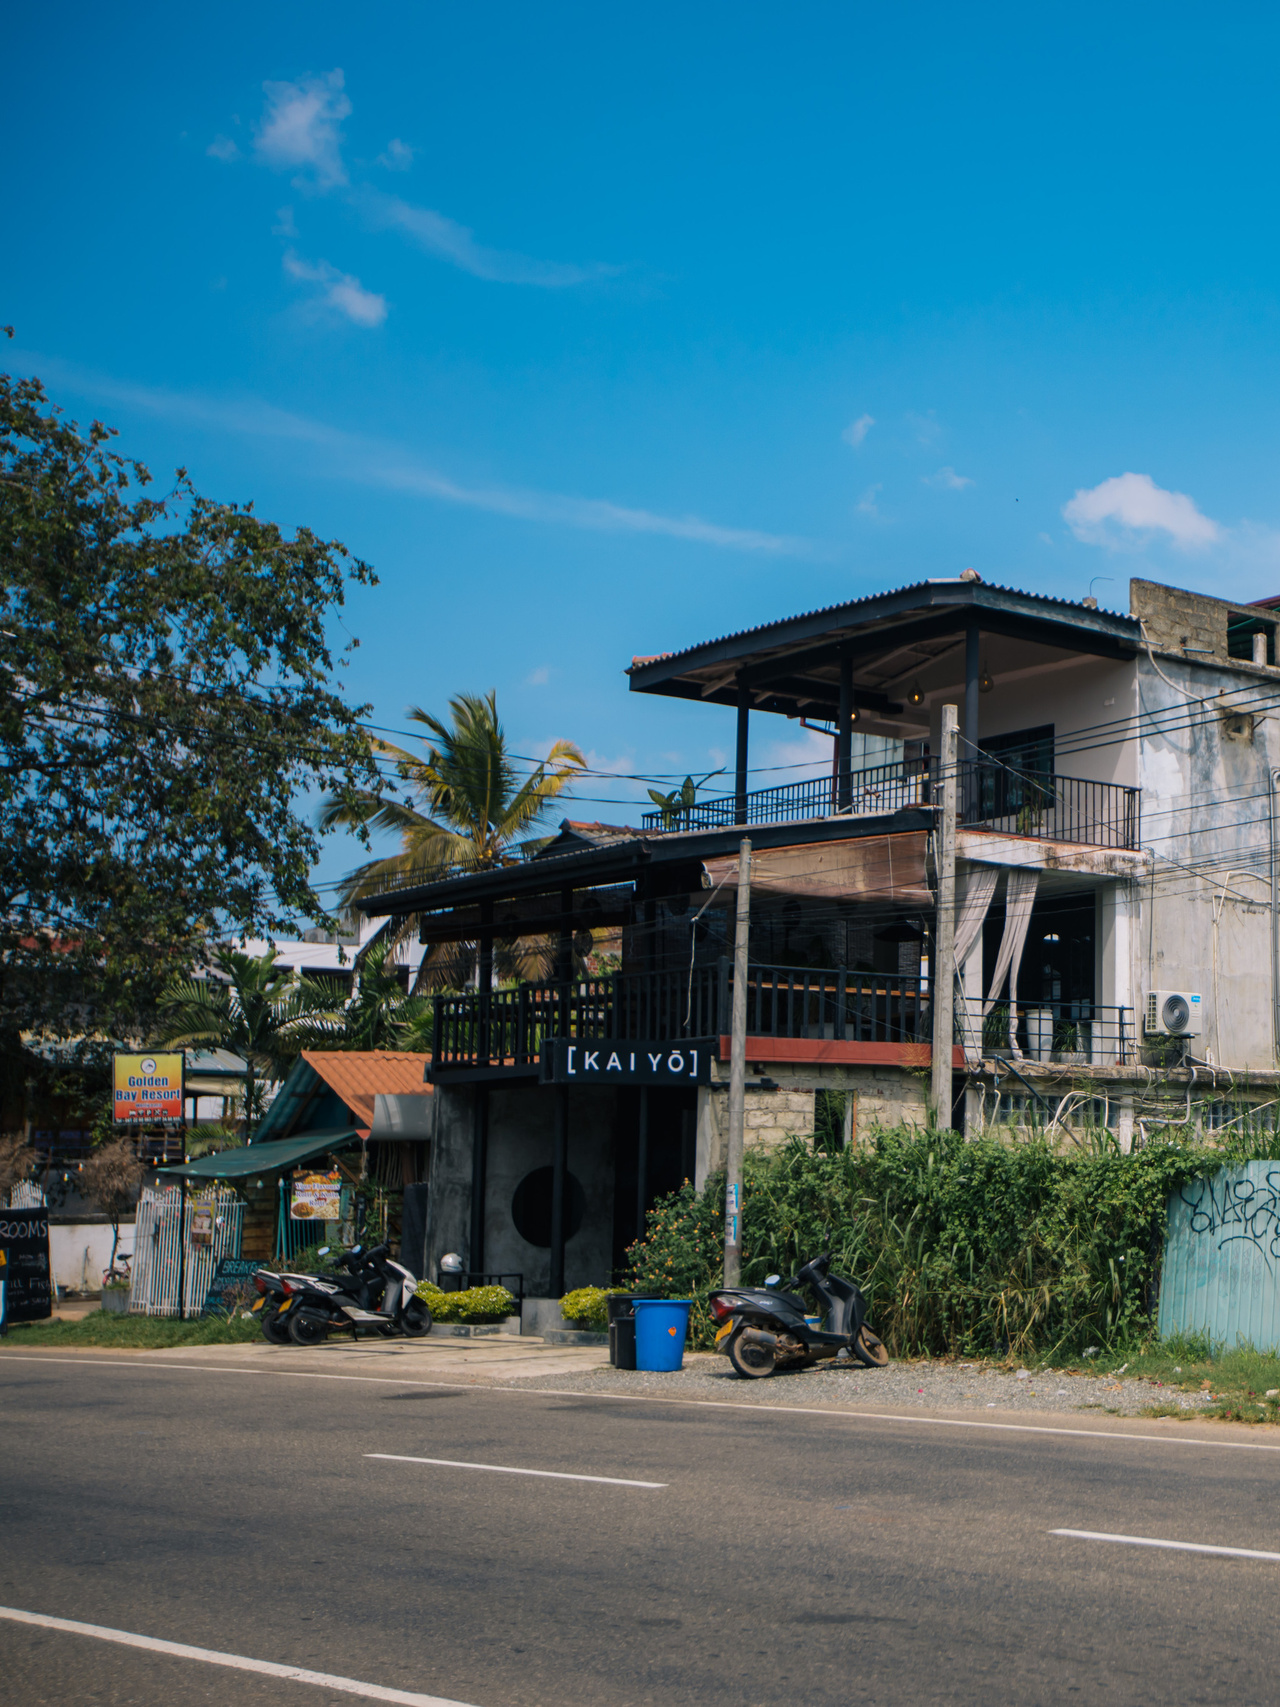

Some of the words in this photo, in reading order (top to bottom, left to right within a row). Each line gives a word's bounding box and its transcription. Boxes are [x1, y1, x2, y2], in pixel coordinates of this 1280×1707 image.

[128, 1075, 169, 1088] Golden
[115, 1089, 137, 1102] Bay
[141, 1088, 181, 1101] Resort
[0, 1219, 48, 1239] ROOMS
